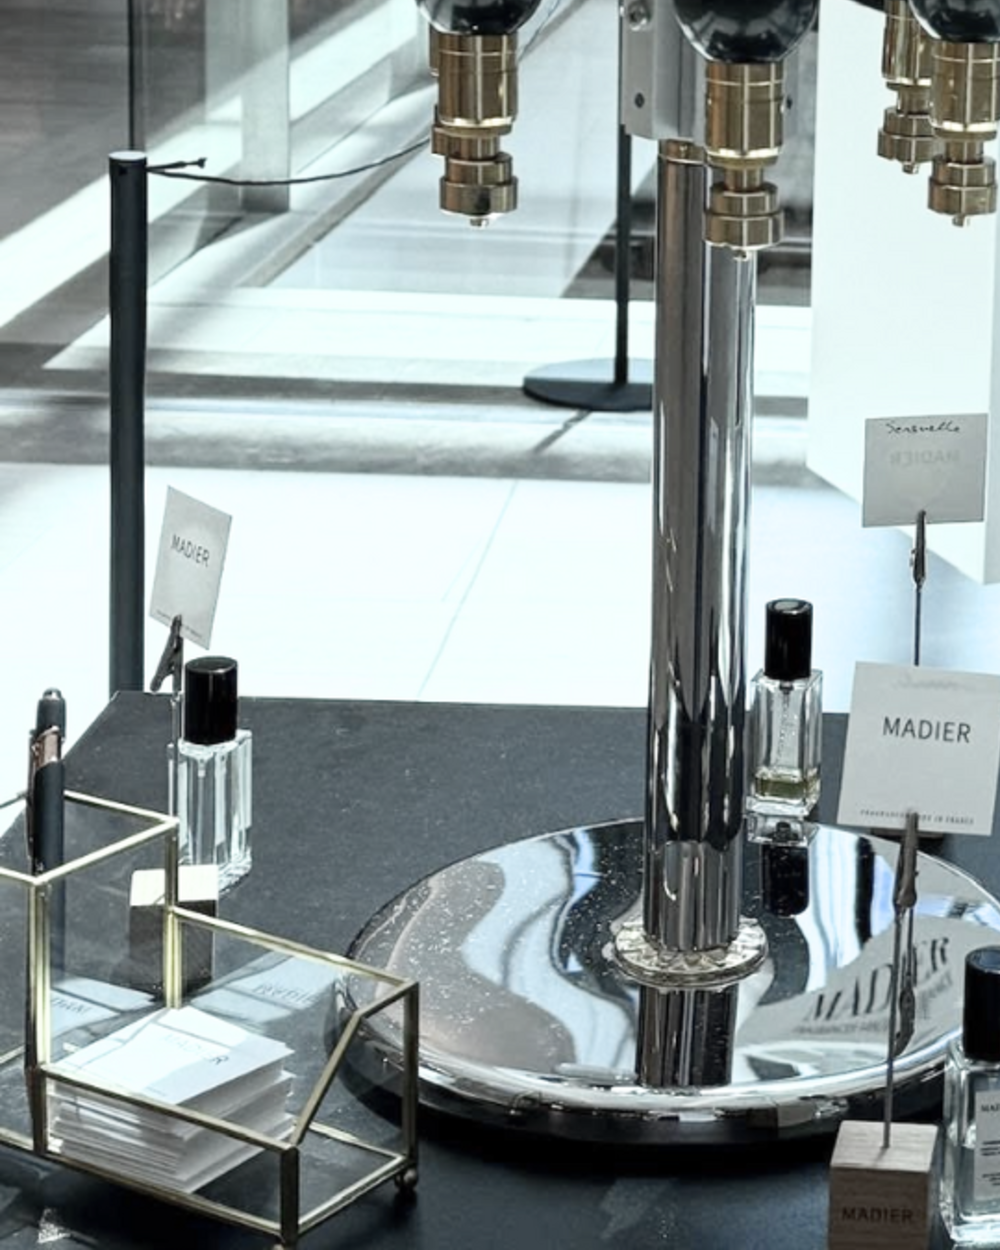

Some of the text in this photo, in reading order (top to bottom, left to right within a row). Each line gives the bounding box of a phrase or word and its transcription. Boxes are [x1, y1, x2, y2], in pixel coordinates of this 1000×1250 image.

[170, 533, 210, 568] MADIER
[882, 715, 972, 744] MADIER
[841, 1206, 914, 1224] MADIER
